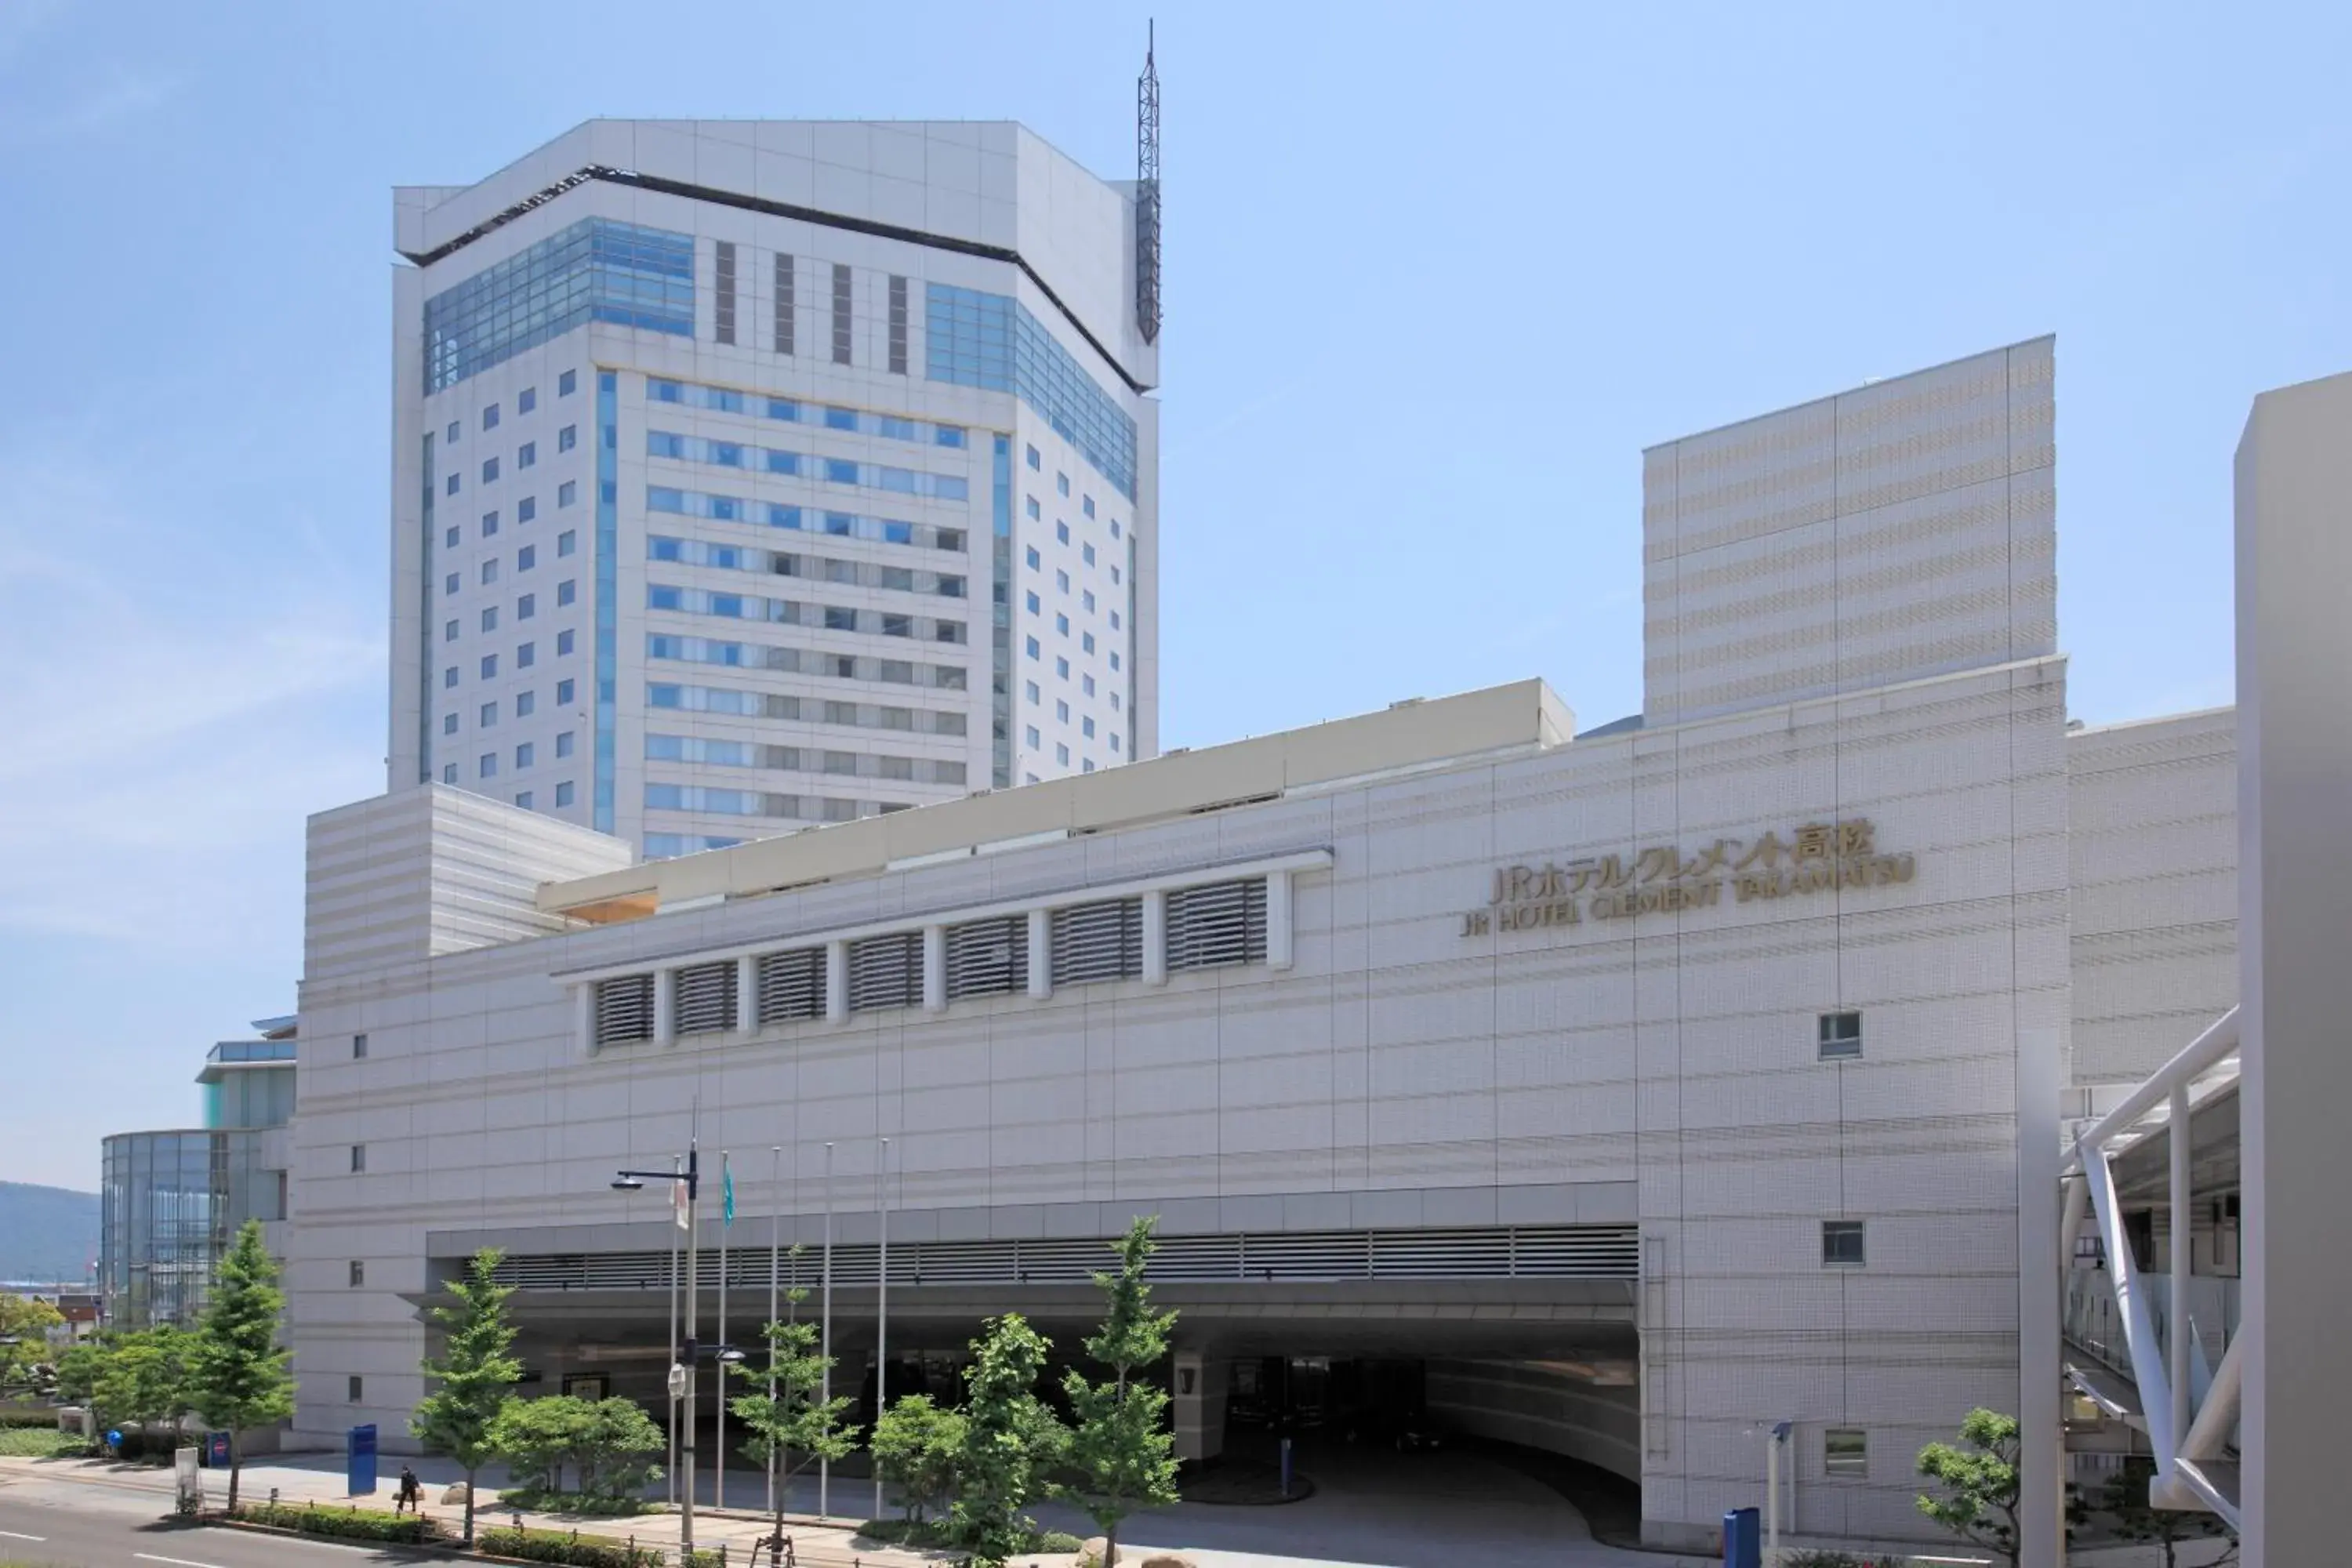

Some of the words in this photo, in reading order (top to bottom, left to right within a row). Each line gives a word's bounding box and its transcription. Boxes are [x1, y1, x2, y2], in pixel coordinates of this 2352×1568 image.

[1459, 911, 1489, 938] JR
[1498, 898, 1582, 932] HOTEL
[1588, 876, 1723, 920] CLEMENT
[1730, 851, 1915, 904] TAKAMATSU
